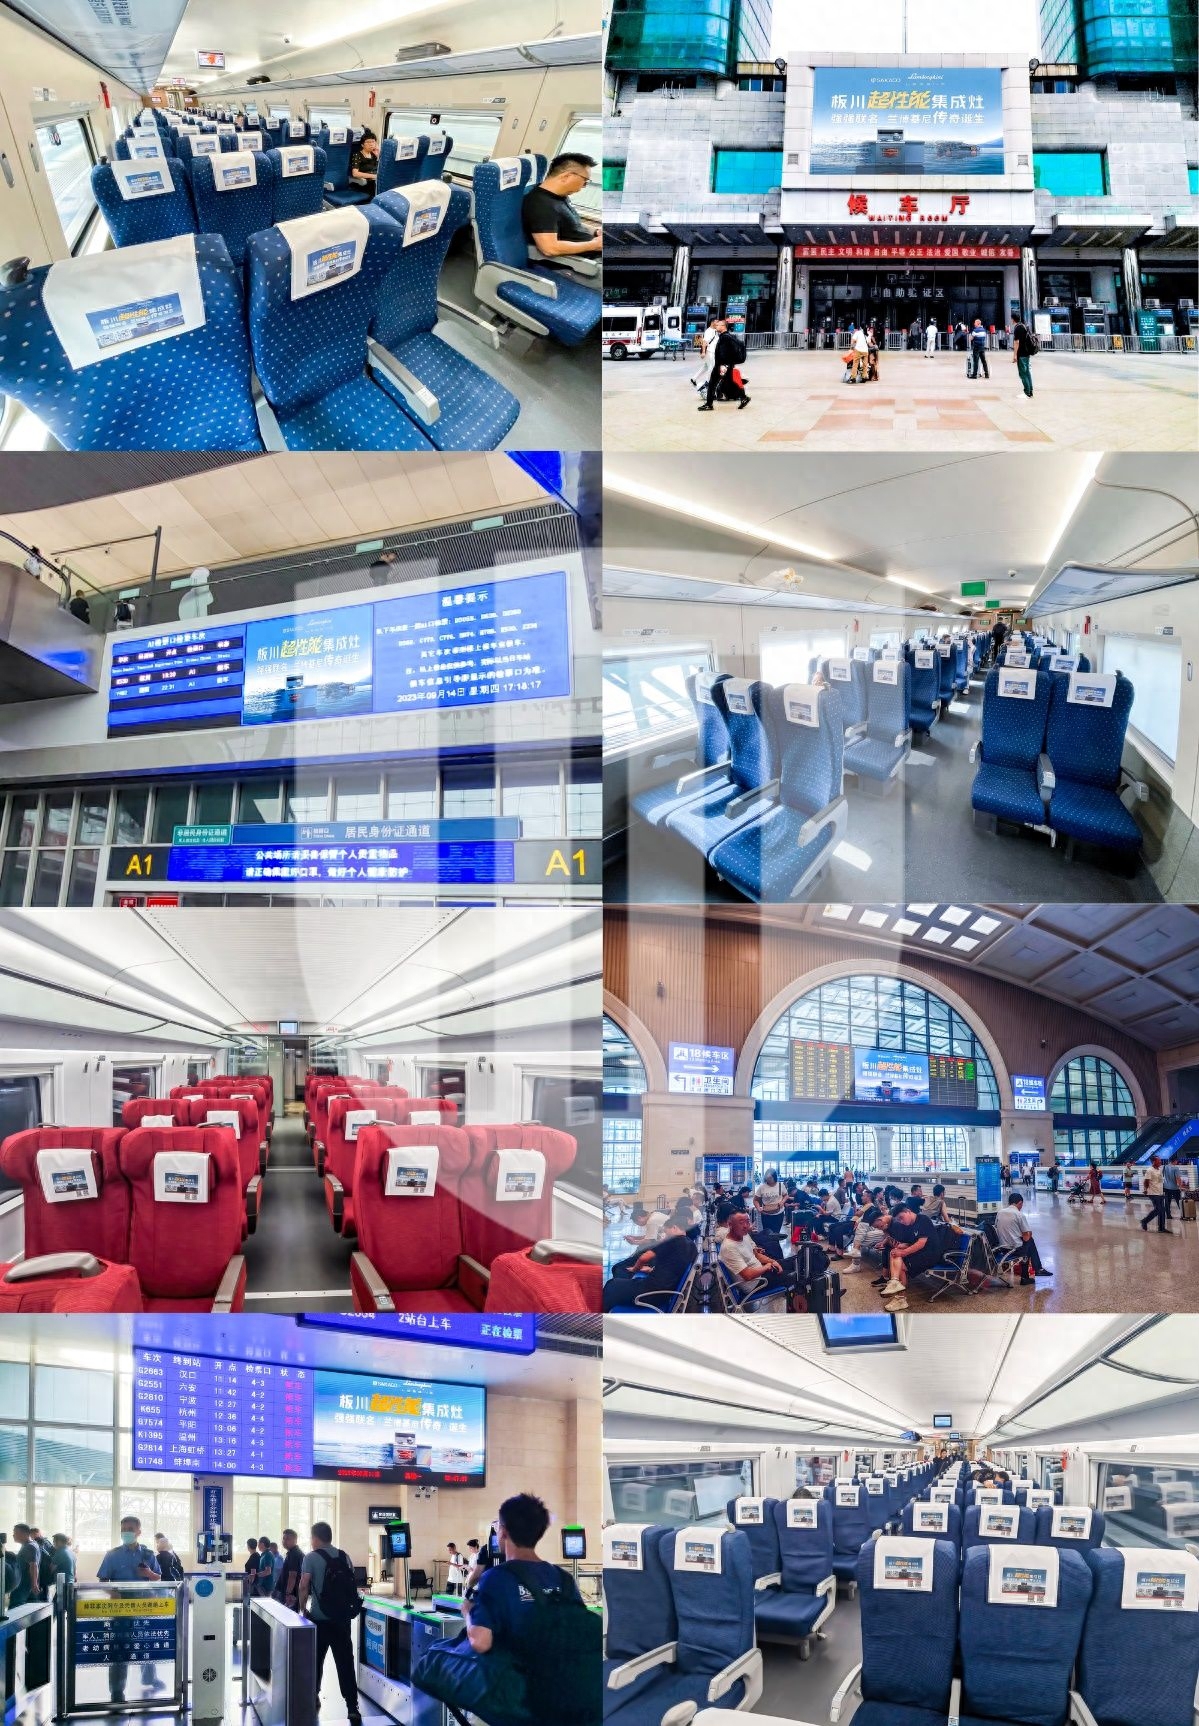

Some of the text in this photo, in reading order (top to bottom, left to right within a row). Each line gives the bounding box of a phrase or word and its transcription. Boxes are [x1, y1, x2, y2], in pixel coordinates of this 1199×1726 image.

[831, 90, 984, 110] 板川超性能集成灶
[831, 111, 984, 124] 强强联名 兰博基尼传奇诞生
[847, 194, 970, 216] 候车厅
[820, 247, 834, 257] 民主
[838, 247, 852, 257] 文明
[874, 247, 888, 257] 自由
[891, 247, 906, 257] 平等
[908, 247, 922, 257] 公正
[944, 247, 958, 257] 爱国
[962, 247, 976, 257] 敬业
[883, 288, 944, 298] 自助验证区
[442, 590, 488, 607] 温馨提示
[397, 680, 542, 702] 2023年09月14日 星期四 17:18:17
[344, 825, 430, 838] 居民身份证通道
[126, 853, 152, 876] A1
[545, 848, 586, 876] A1
[690, 1048, 729, 1060] 18候车区
[704, 1077, 729, 1085] 卫生间
[398, 1313, 451, 1330] 2站台上车
[481, 1324, 522, 1340] 正在检票
[143, 1353, 162, 1363] 车次
[172, 1356, 200, 1367] 终到站
[246, 1365, 271, 1375] 检票口
[180, 1370, 196, 1379] 汉口
[138, 1380, 162, 1389] G2551
[179, 1384, 196, 1392] 六安
[138, 1393, 163, 1401] G2810
[180, 1396, 196, 1405] 宁波
[140, 1406, 160, 1414] K655
[179, 1408, 196, 1417] 杭州
[214, 1424, 236, 1432] 13:06
[138, 1431, 162, 1440] K1395
[179, 1433, 196, 1442] 温州
[170, 1445, 204, 1454] 上海虹桥
[214, 1448, 236, 1456] 13:27
[174, 1458, 200, 1467] 蚌埠南
[104, 1653, 150, 1661] 人通道
